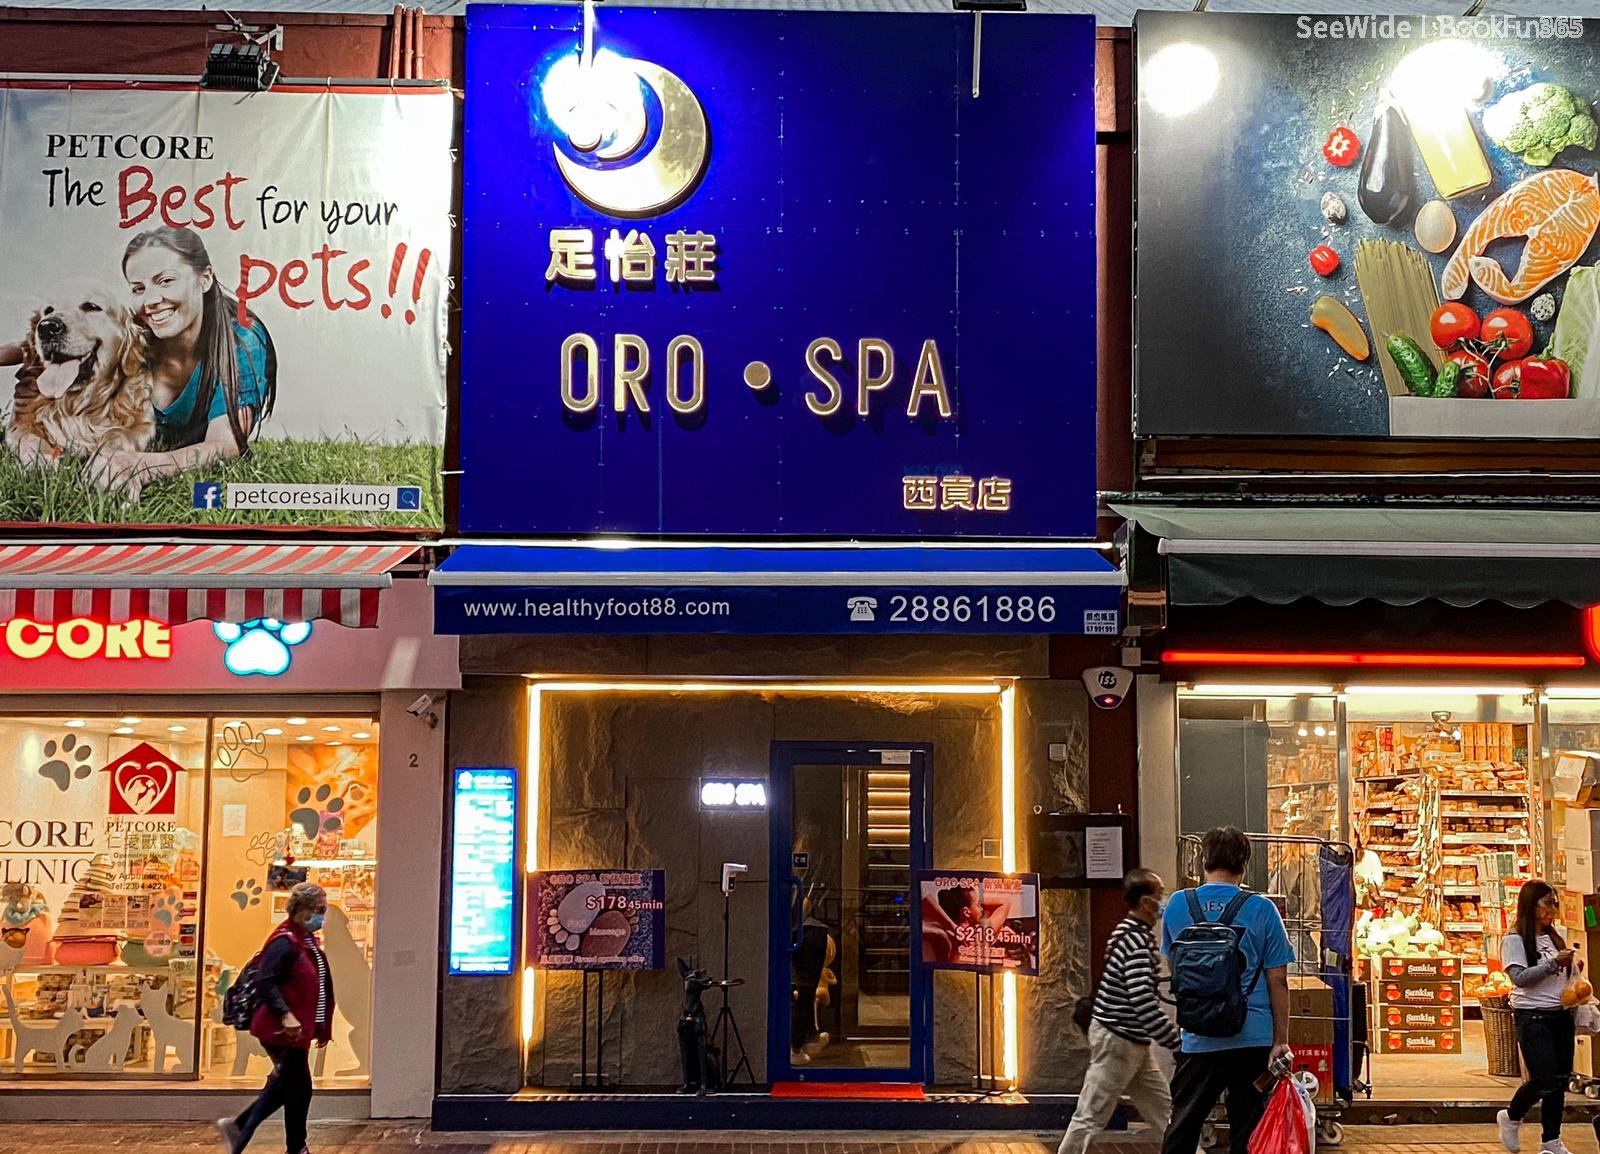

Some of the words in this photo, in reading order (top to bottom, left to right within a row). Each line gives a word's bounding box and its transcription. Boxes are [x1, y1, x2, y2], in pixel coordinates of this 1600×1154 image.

[46, 135, 214, 160] PETCORE
[42, 167, 106, 208] The
[117, 165, 249, 230] Best
[256, 185, 309, 230] for
[320, 200, 399, 234] your
[544, 229, 718, 284] 足怡莊
[236, 242, 432, 328] pets!!
[560, 332, 704, 414] ORO
[805, 338, 952, 418] SPA
[234, 487, 391, 511] petcoresaikung
[902, 475, 1011, 511] 西貢店
[464, 598, 730, 620] www.healthyfoot88.com
[889, 596, 1056, 623] 28861886
[0, 618, 171, 659] CORE
[408, 753, 418, 768] 2
[106, 821, 176, 833] PETCORE
[0, 858, 91, 884] LINIC
[586, 895, 627, 910] $178
[627, 899, 663, 910] 45min
[956, 926, 994, 942] $218
[997, 931, 1031, 944] 45min
